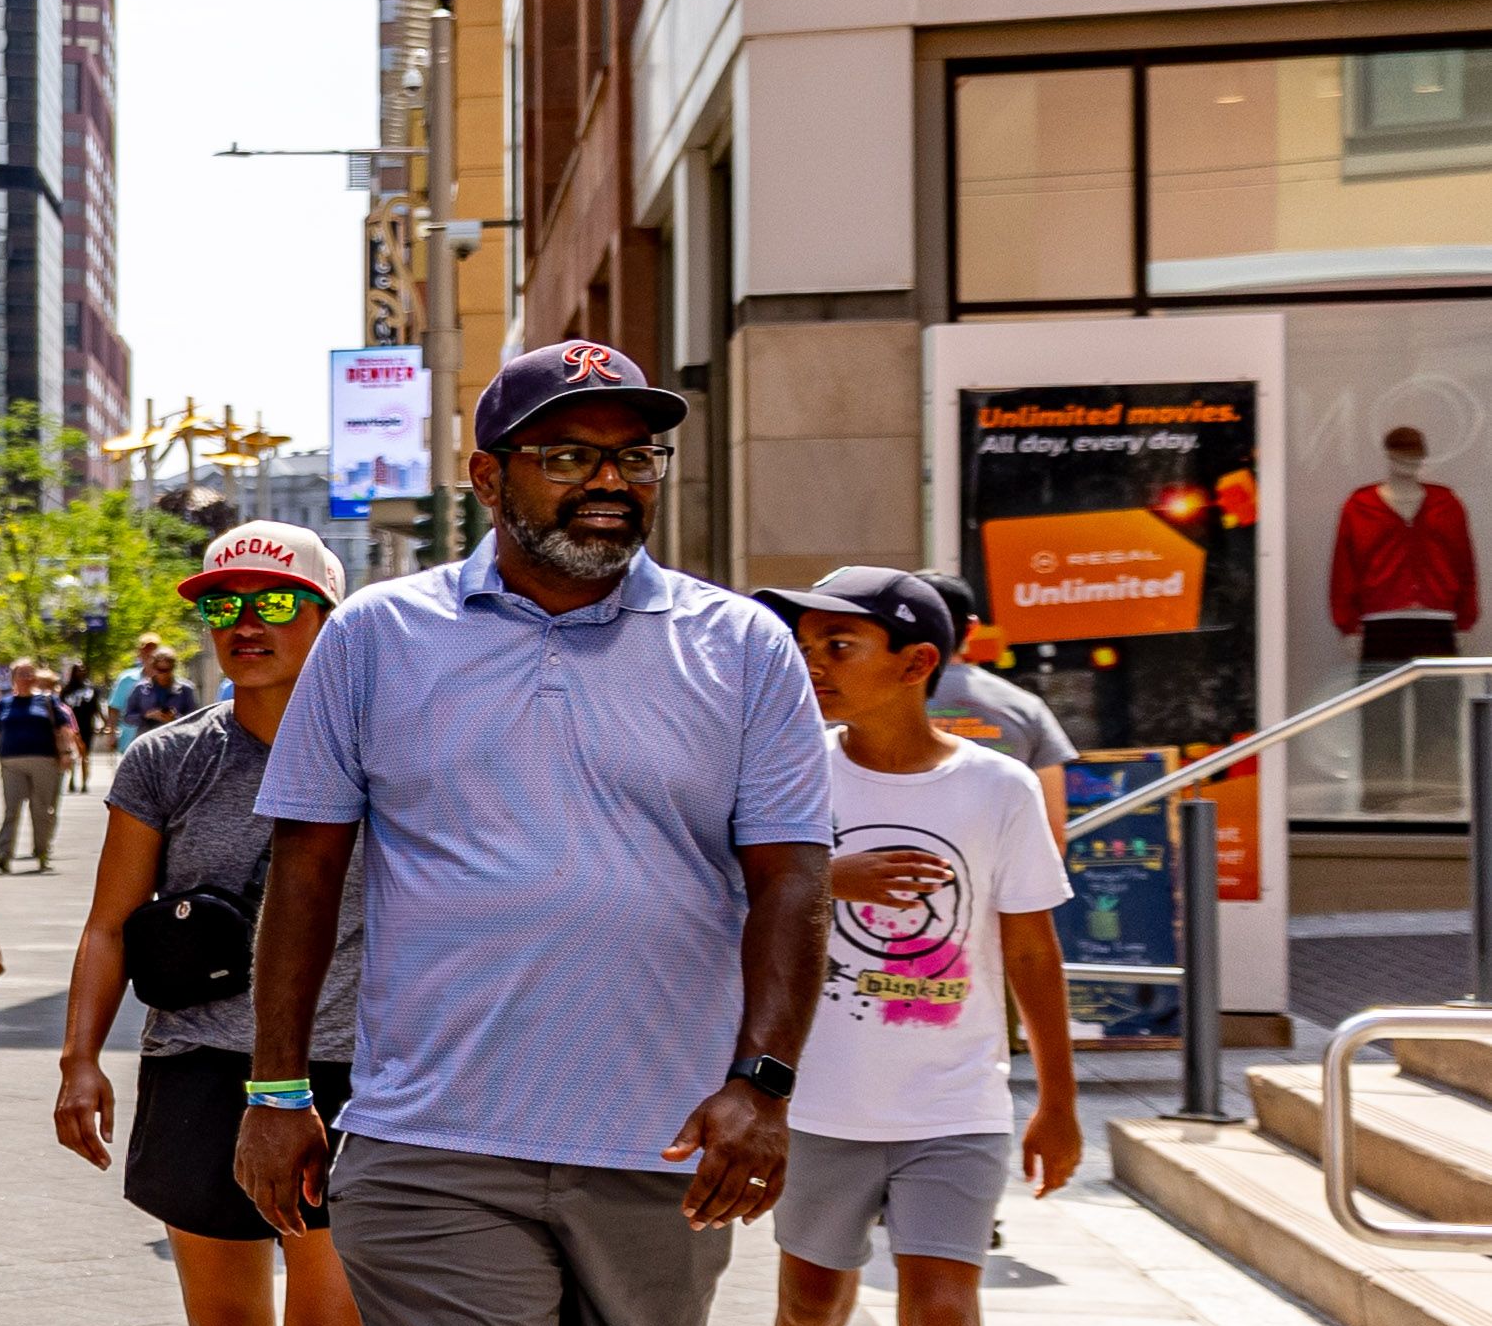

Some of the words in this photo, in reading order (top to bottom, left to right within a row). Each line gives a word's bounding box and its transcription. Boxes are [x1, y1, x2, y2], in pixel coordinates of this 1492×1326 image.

[346, 366, 415, 383] DENVER
[561, 345, 622, 384] R
[978, 403, 1123, 428] Unlimited
[1124, 400, 1242, 424] movies.
[978, 434, 1015, 454] All
[1073, 434, 1146, 455] every
[1145, 431, 1200, 454] day.
[214, 538, 295, 567] TACOMA
[1066, 550, 1162, 566] REGAL
[1013, 570, 1185, 607] Unlimited
